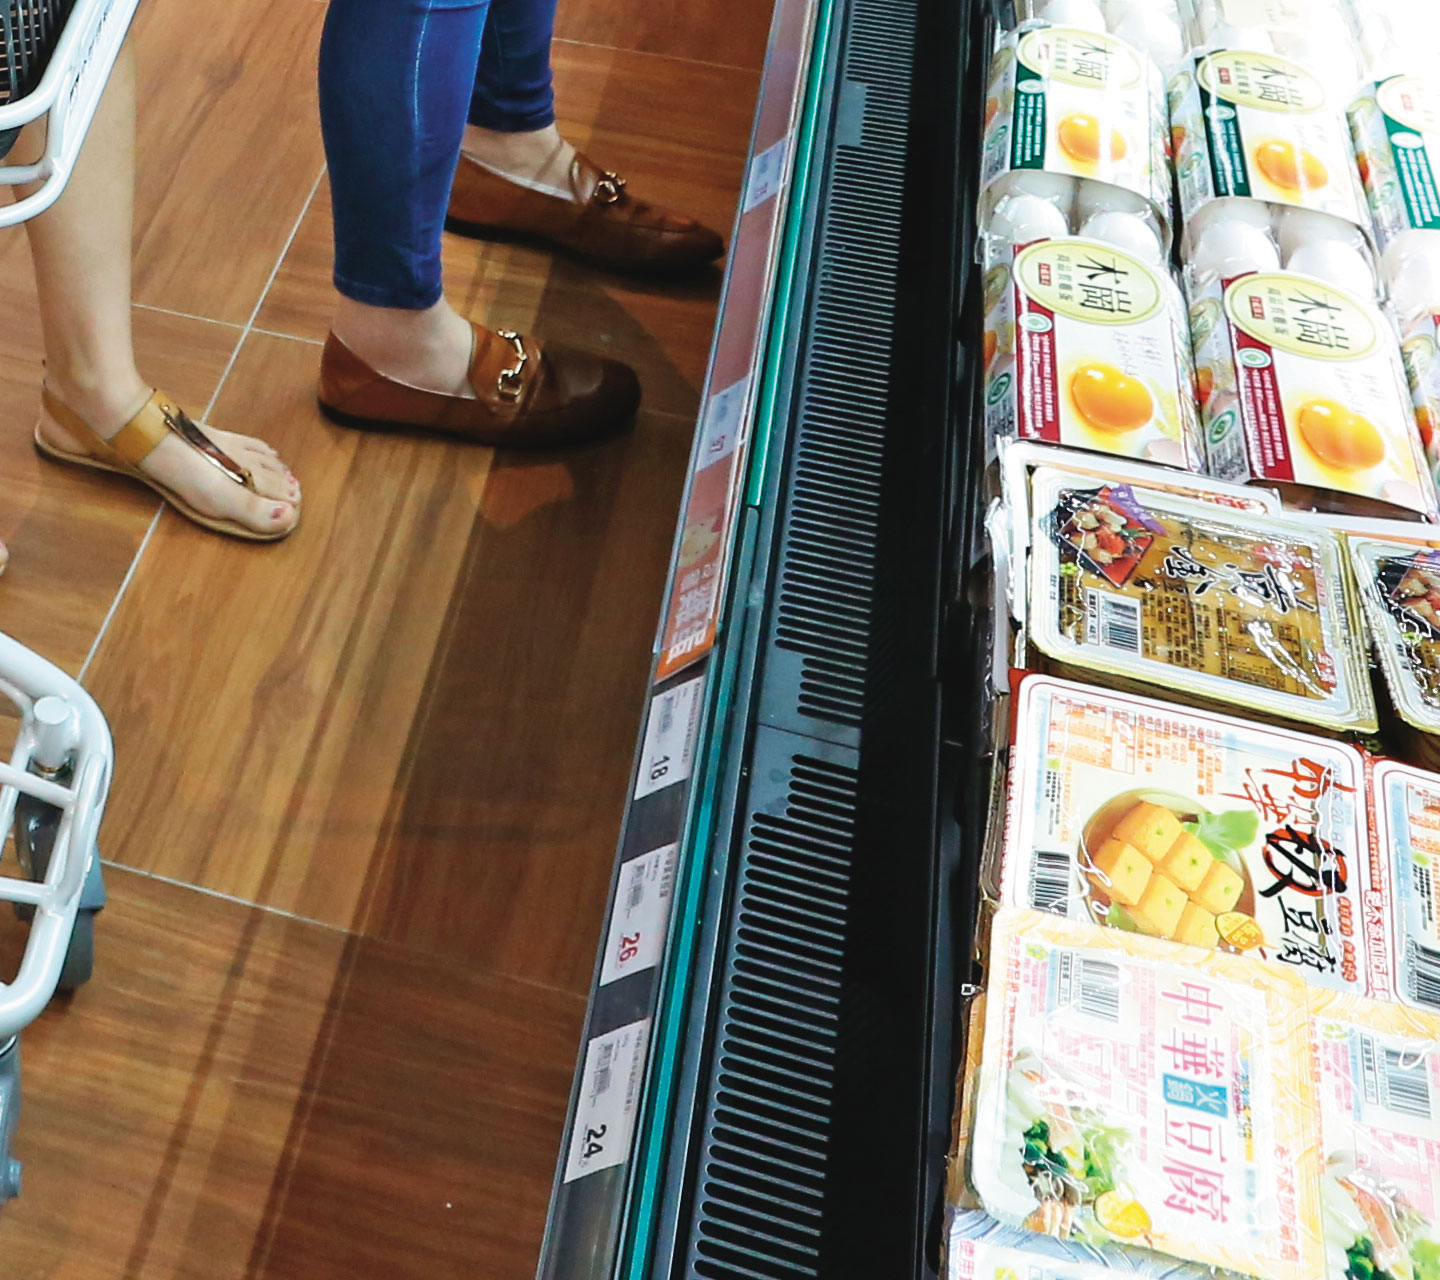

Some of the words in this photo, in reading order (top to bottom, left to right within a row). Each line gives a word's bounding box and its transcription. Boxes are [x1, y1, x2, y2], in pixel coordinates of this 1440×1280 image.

[650, 755, 670, 782] 18
[618, 931, 641, 964] 26
[583, 1122, 607, 1159] 24
